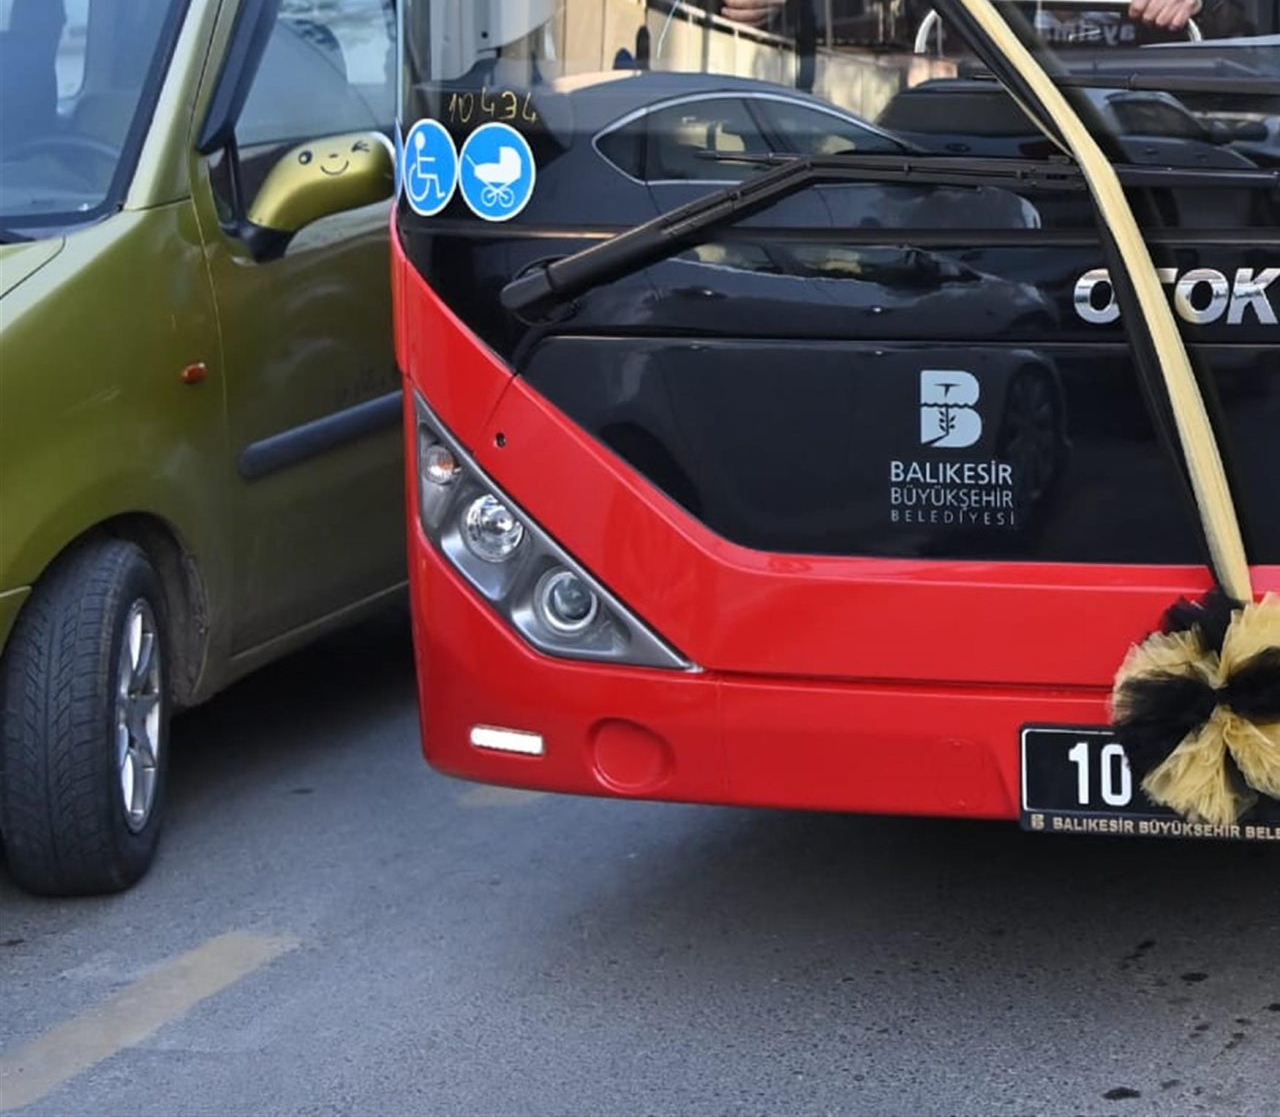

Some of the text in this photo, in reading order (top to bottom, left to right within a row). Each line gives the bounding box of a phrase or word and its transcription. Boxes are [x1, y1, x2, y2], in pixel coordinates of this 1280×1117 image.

[890, 460, 1013, 484] BALIKESİR
[890, 484, 1014, 510] BÜYÜKŞEHİR
[890, 509, 1015, 526] BELEDİYESİ
[1068, 742, 1132, 806] 10
[1053, 817, 1135, 833] BALIKESİR
